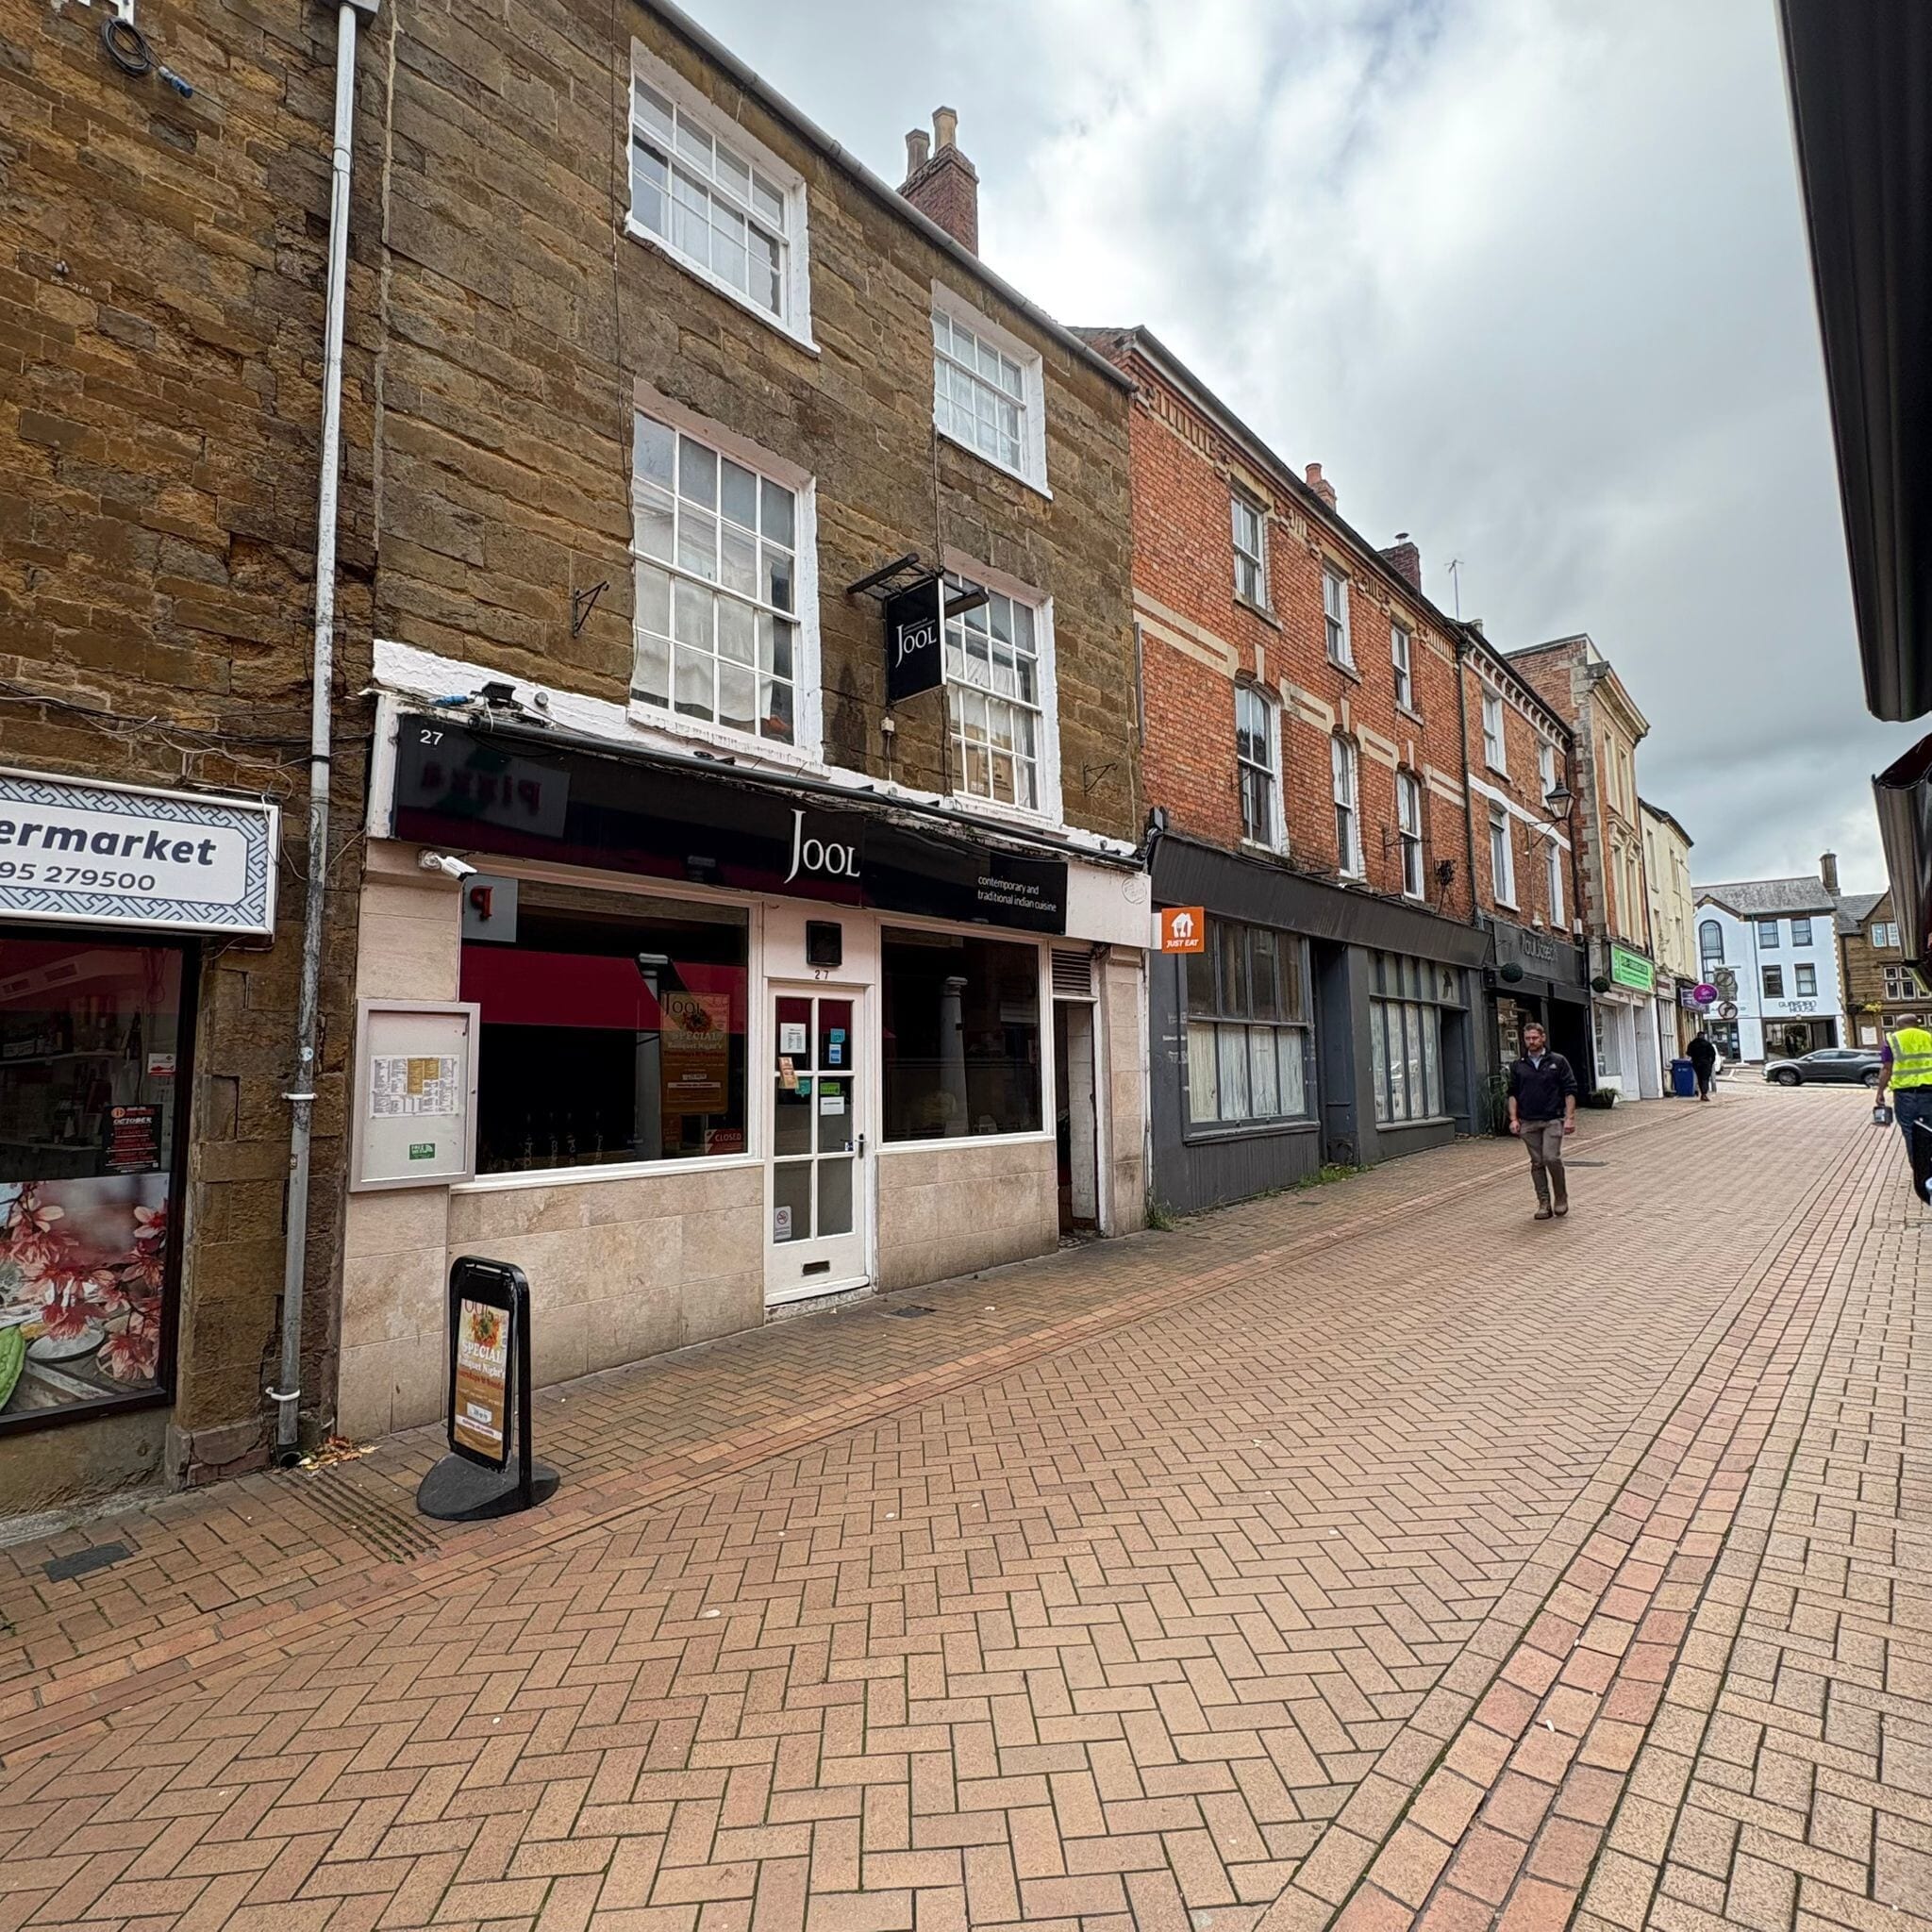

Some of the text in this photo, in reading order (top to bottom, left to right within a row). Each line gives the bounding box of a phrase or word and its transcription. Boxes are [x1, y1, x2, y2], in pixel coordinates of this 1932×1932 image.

[895, 624, 937, 669] JOOL
[420, 729, 443, 745] 27
[0, 820, 217, 866] ermarket
[783, 808, 860, 884] JOOL
[43, 866, 156, 891] 279500
[977, 875, 1040, 895] contemporary and
[977, 890, 1057, 912] traditional indian cuisine
[1166, 939, 1199, 949] JUST EAT
[814, 969, 829, 980] 27
[714, 1133, 741, 1142] CLOSED
[462, 1341, 502, 1364] SPECIAL
